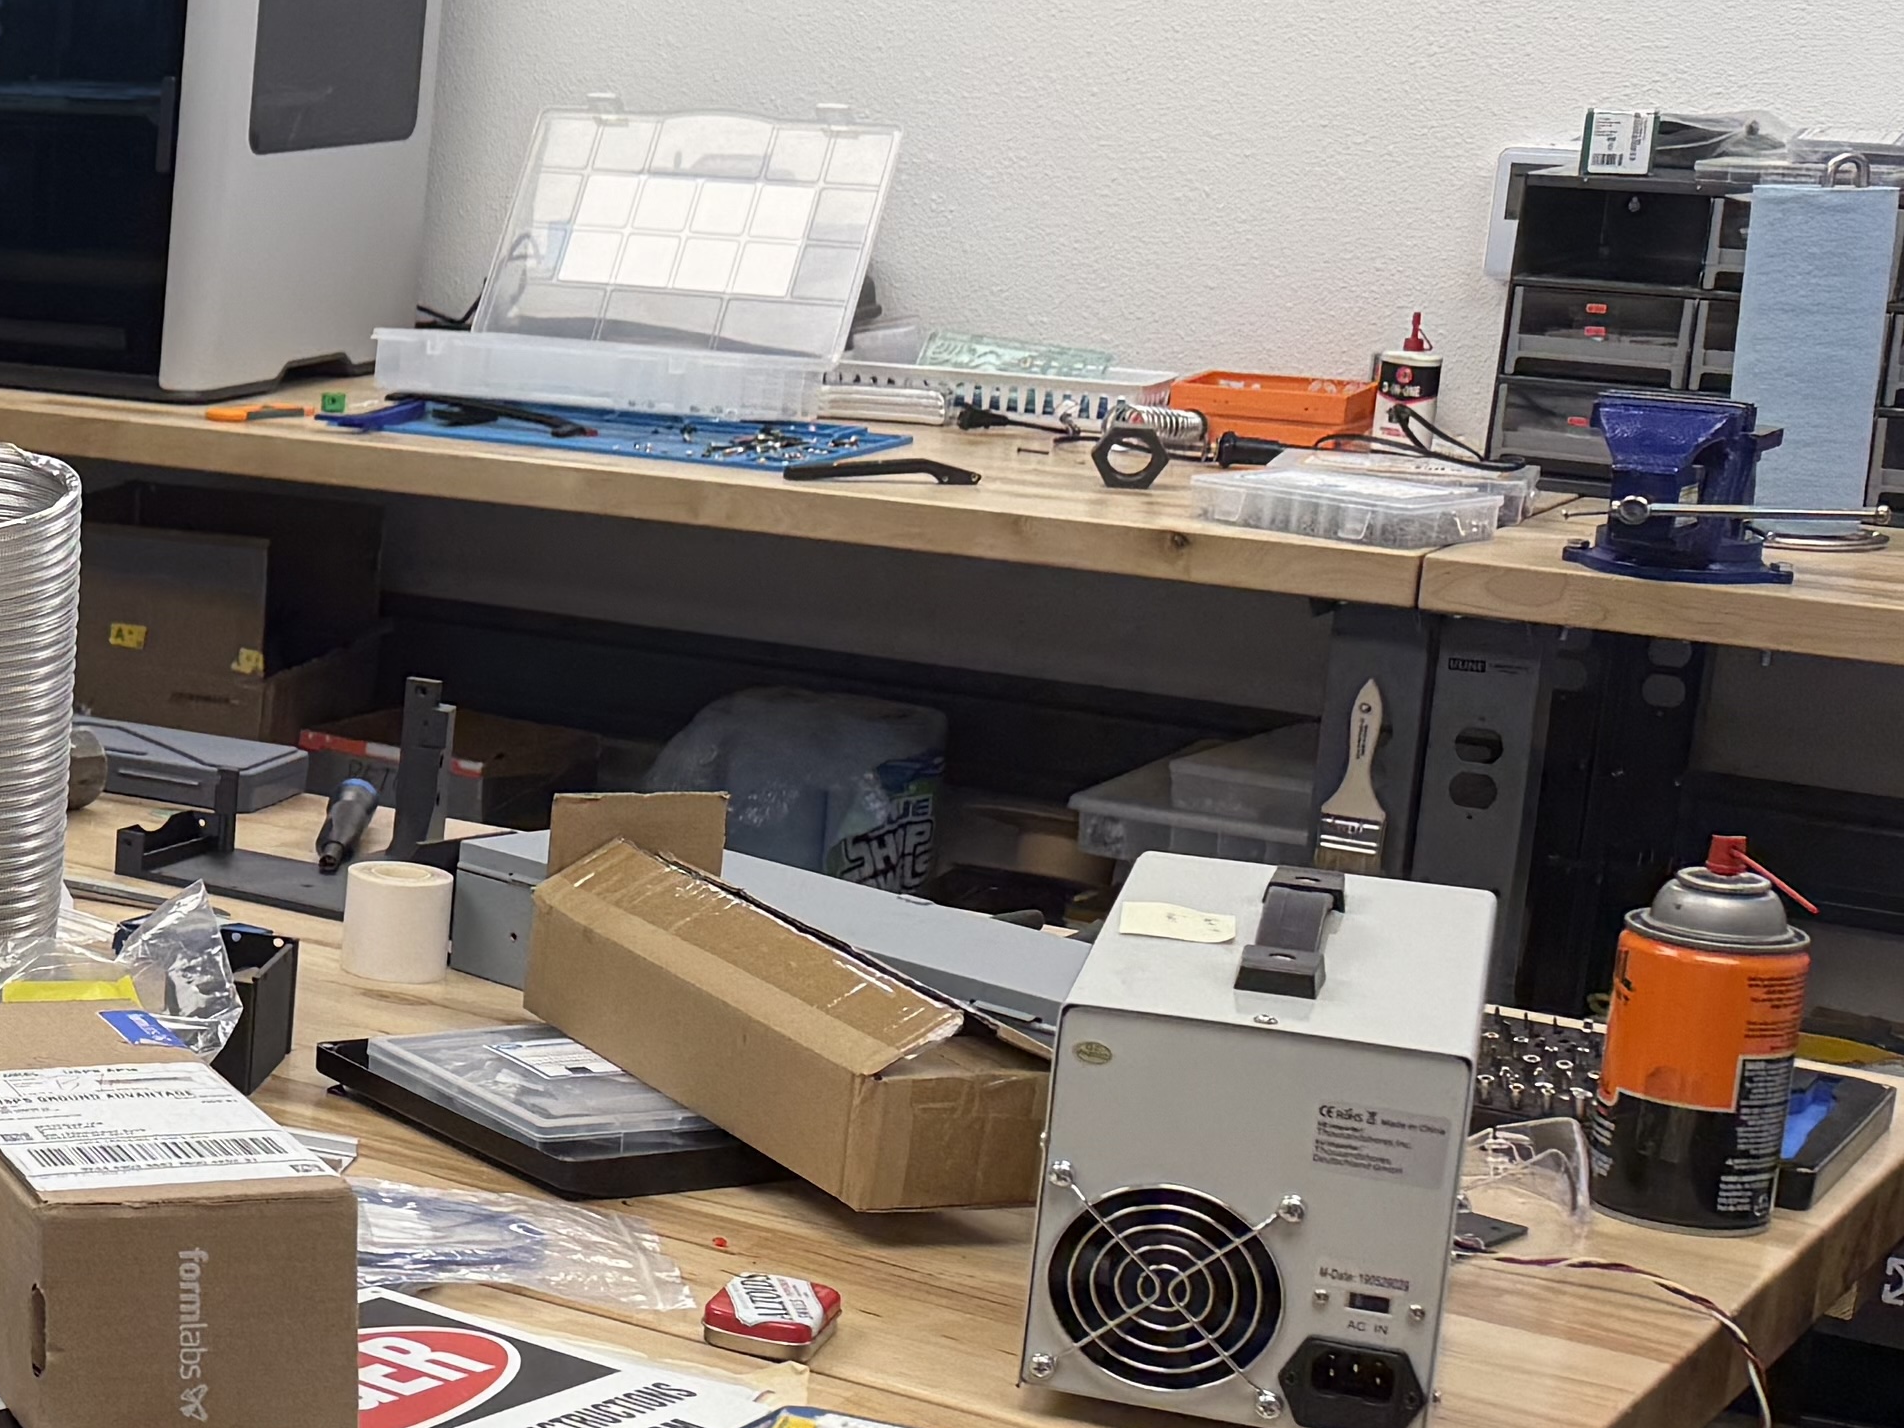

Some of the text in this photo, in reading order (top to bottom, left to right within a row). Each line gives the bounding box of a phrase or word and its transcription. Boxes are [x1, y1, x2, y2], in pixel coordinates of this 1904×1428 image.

[105, 1089, 195, 1103] ADVANTAGE
[178, 1247, 209, 1380] formlabs
[1348, 1320, 1389, 1335] AC IN
